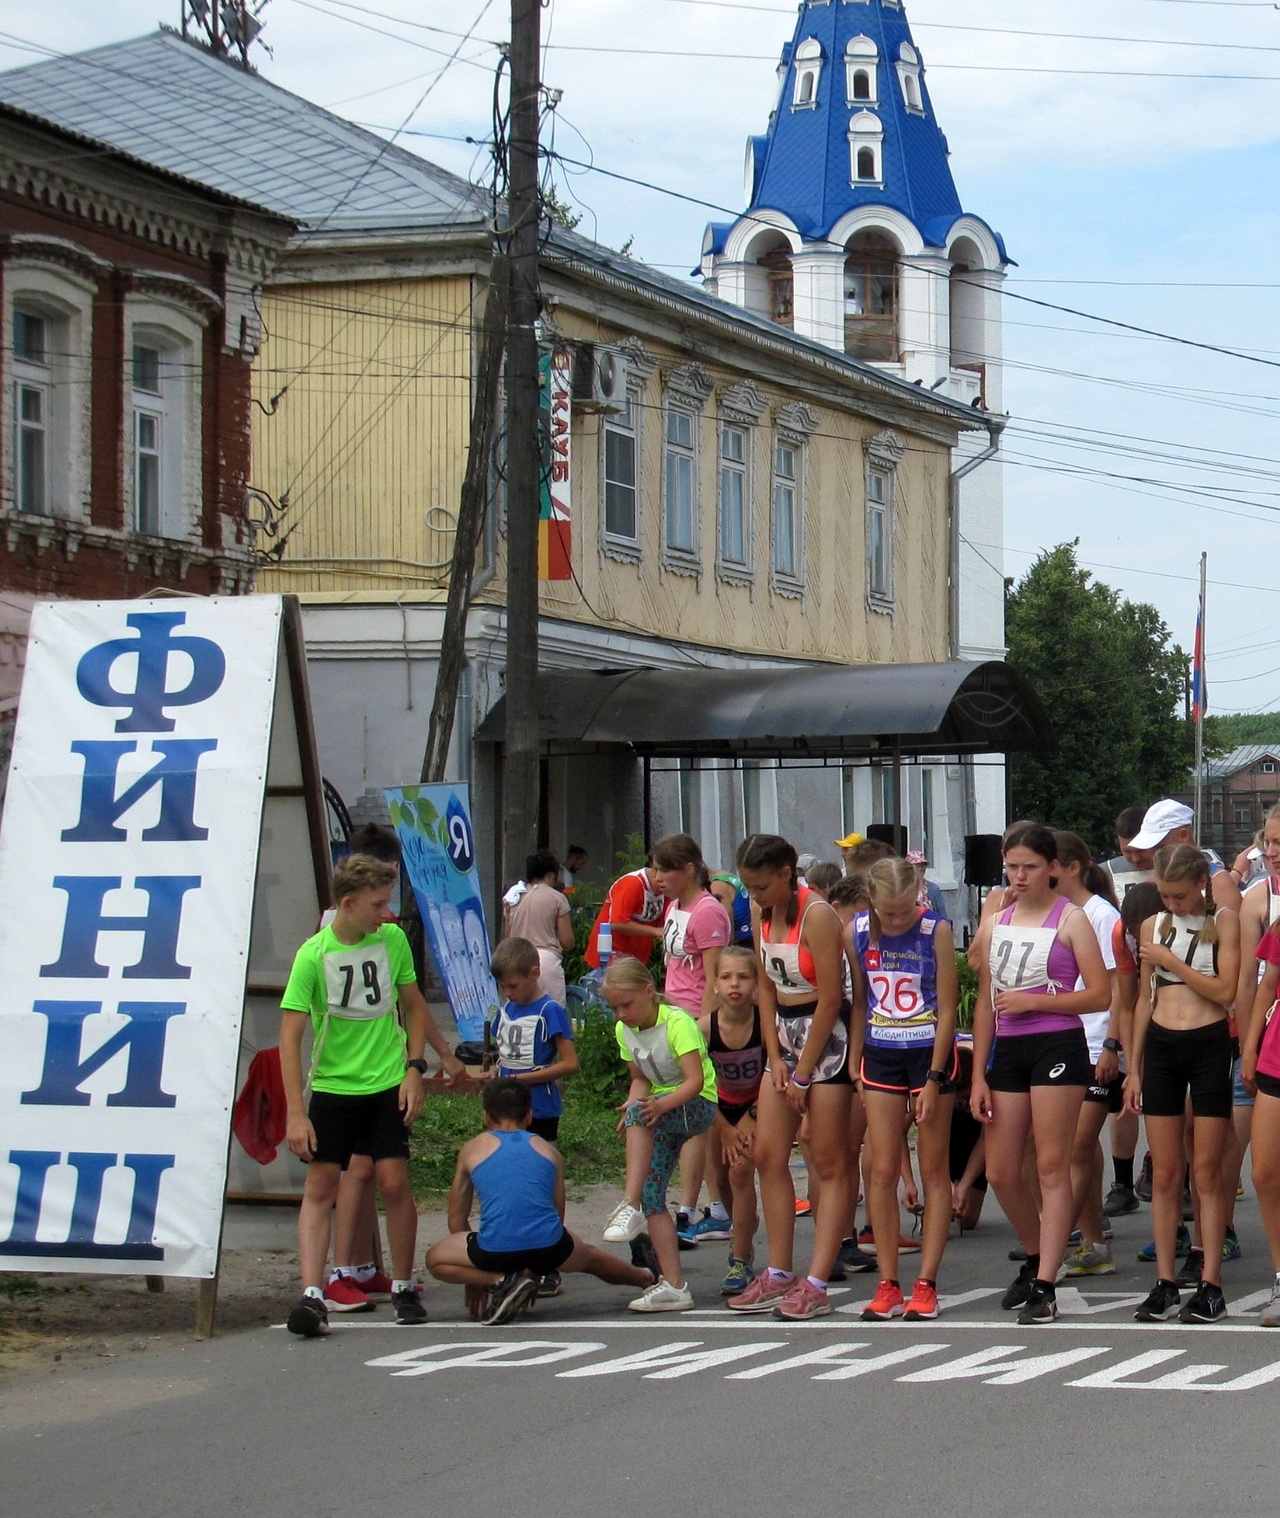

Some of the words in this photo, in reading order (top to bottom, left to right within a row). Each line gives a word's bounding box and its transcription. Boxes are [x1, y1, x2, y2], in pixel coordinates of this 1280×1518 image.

[0, 611, 227, 1261] ФИНИШ
[339, 960, 382, 1008] 79
[997, 939, 1035, 987] 27
[872, 976, 919, 1014] 26
